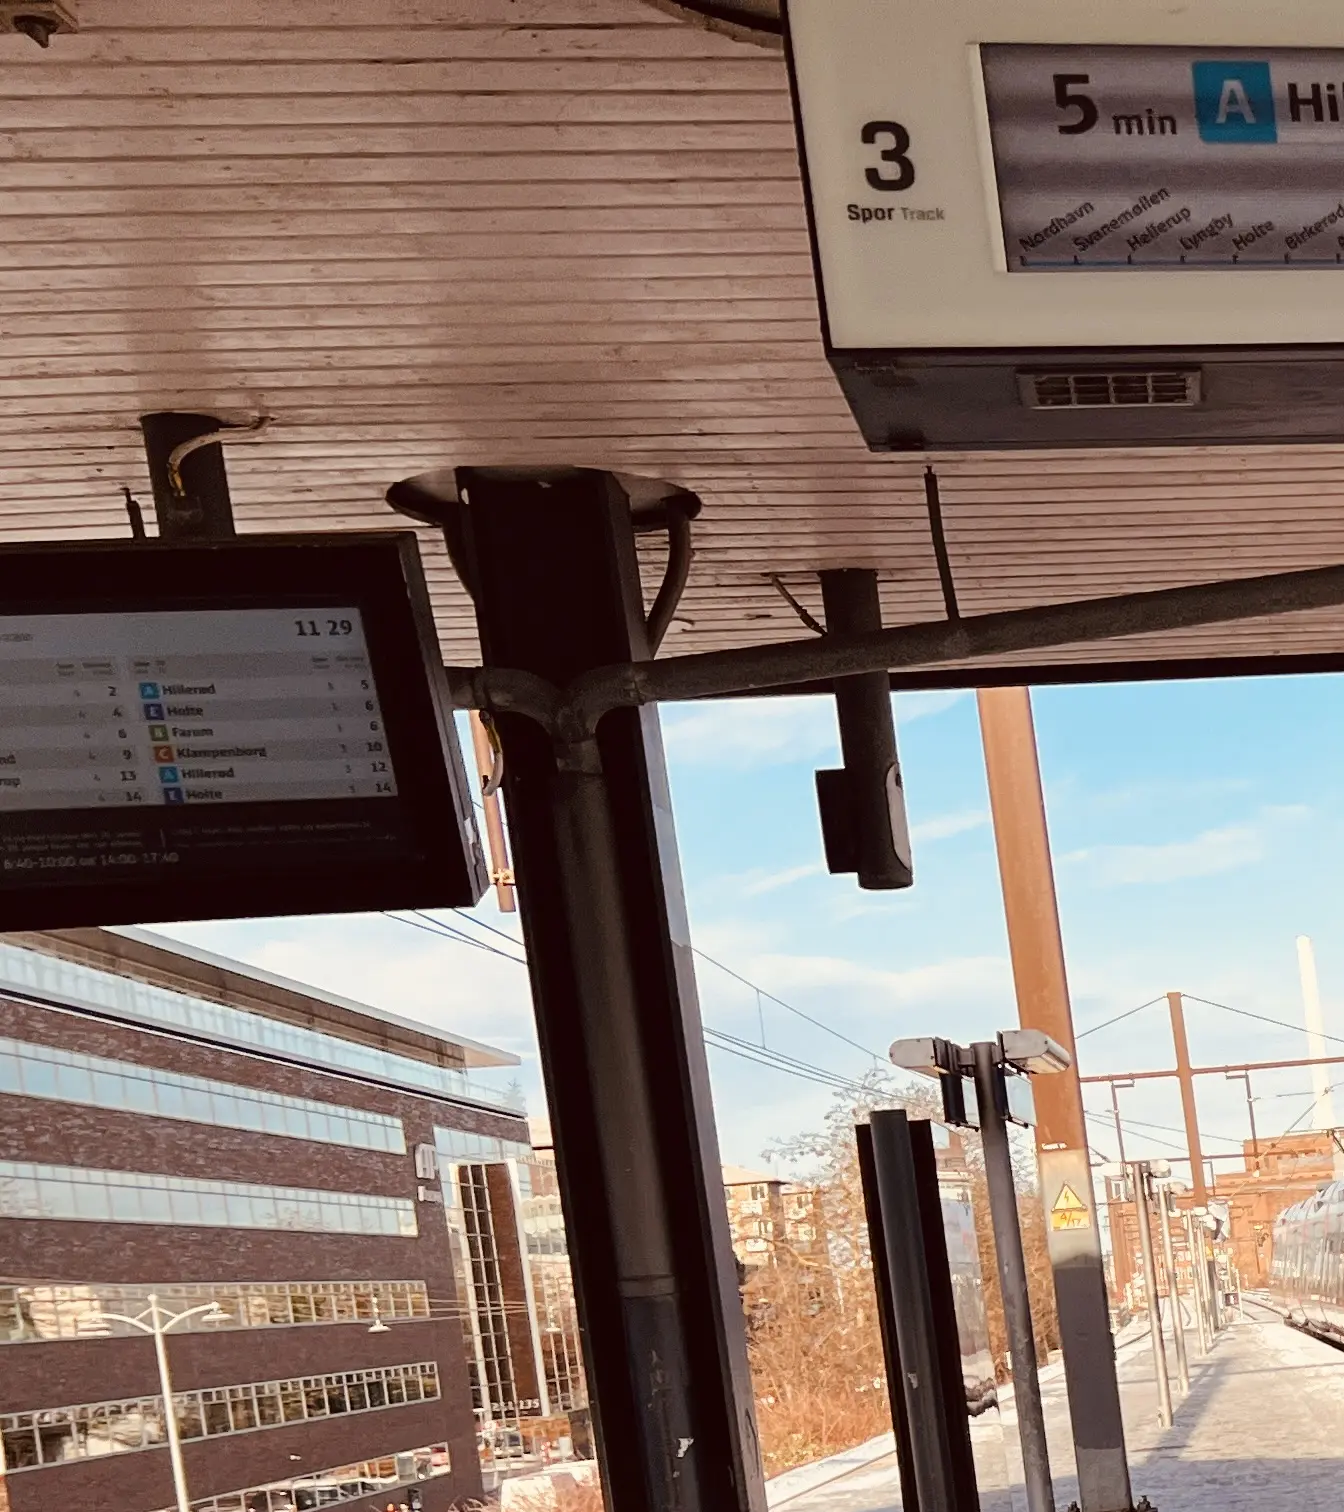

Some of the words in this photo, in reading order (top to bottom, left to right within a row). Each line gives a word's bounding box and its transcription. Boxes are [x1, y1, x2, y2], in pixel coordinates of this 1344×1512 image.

[1053, 73, 1099, 135] 5
[1113, 107, 1177, 136] min
[1215, 79, 1256, 125] A
[860, 120, 916, 191] 3
[847, 203, 894, 223] Spor
[901, 205, 945, 222] Track
[1232, 219, 1275, 252] Holte
[295, 620, 320, 637] 11
[326, 619, 353, 636] 29
